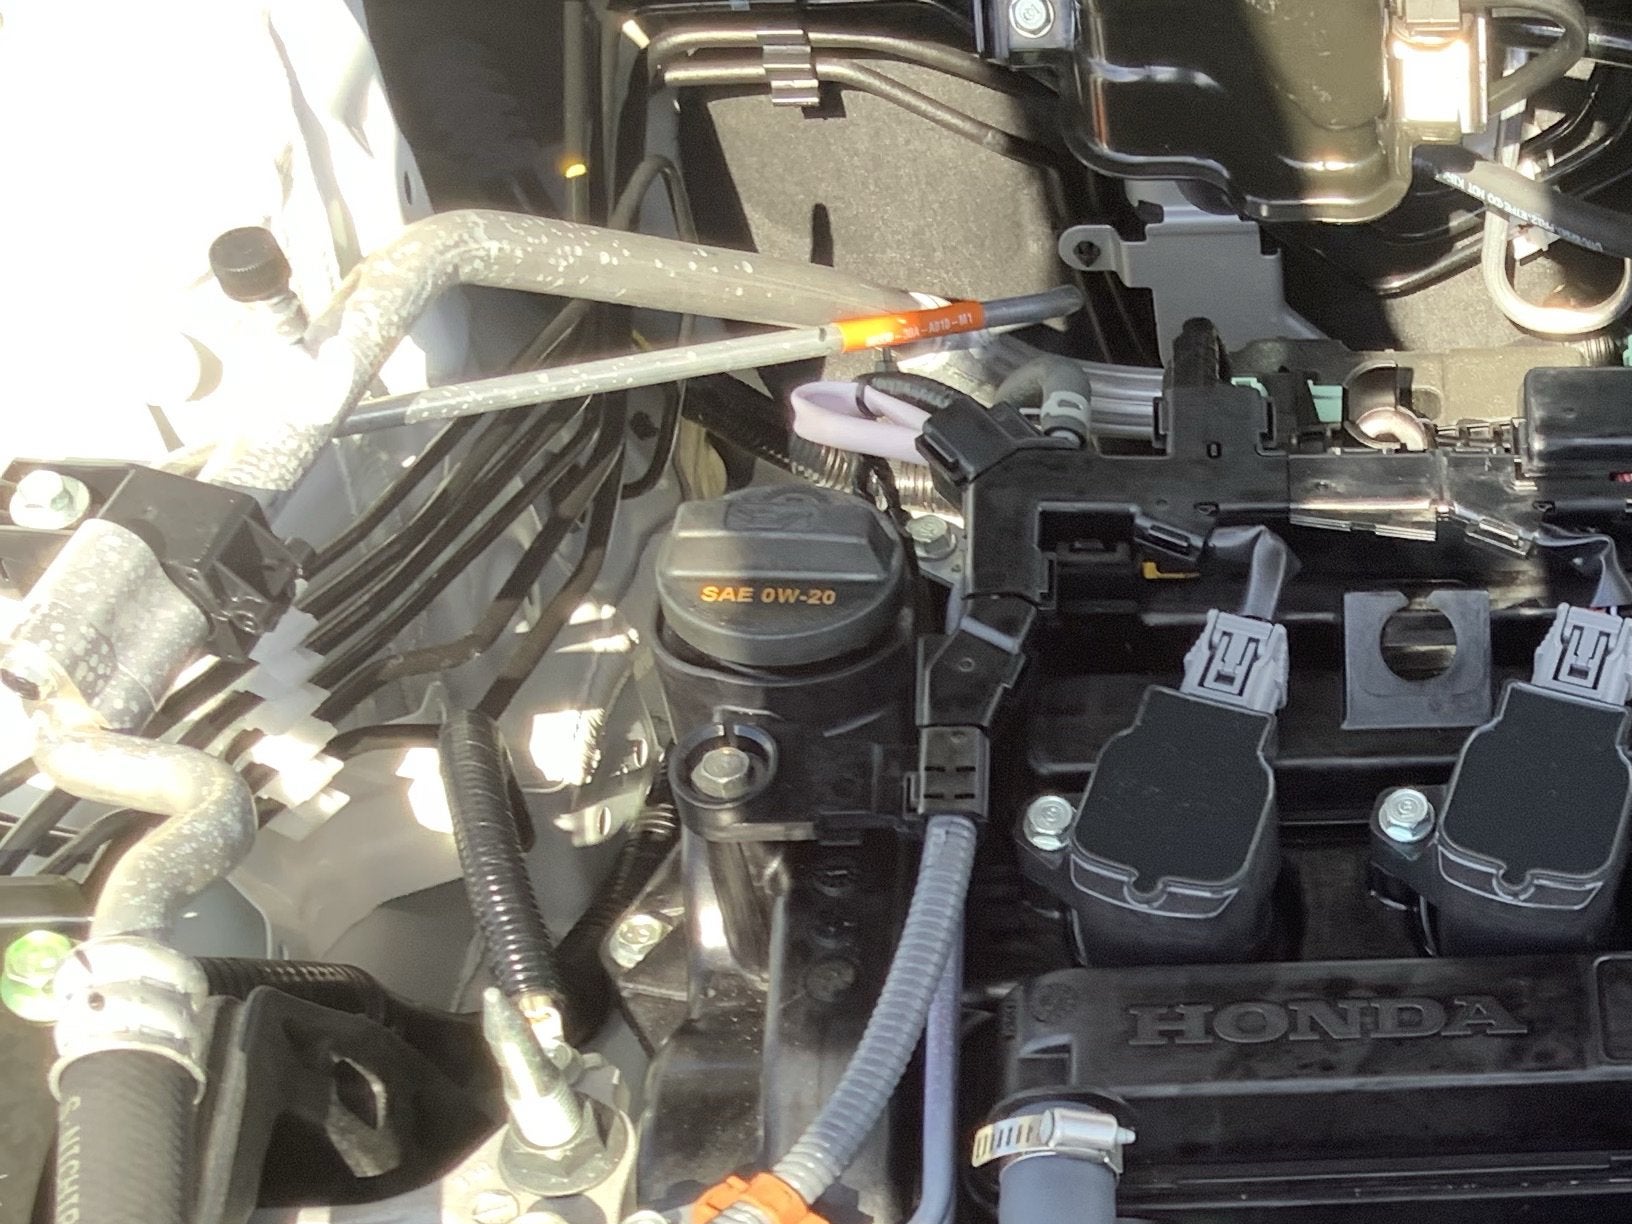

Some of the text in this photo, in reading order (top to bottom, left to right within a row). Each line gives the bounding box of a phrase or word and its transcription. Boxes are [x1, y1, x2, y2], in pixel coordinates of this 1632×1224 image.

[700, 586, 837, 605] SAE 0W-20
[1128, 998, 1528, 1046] HONDA
